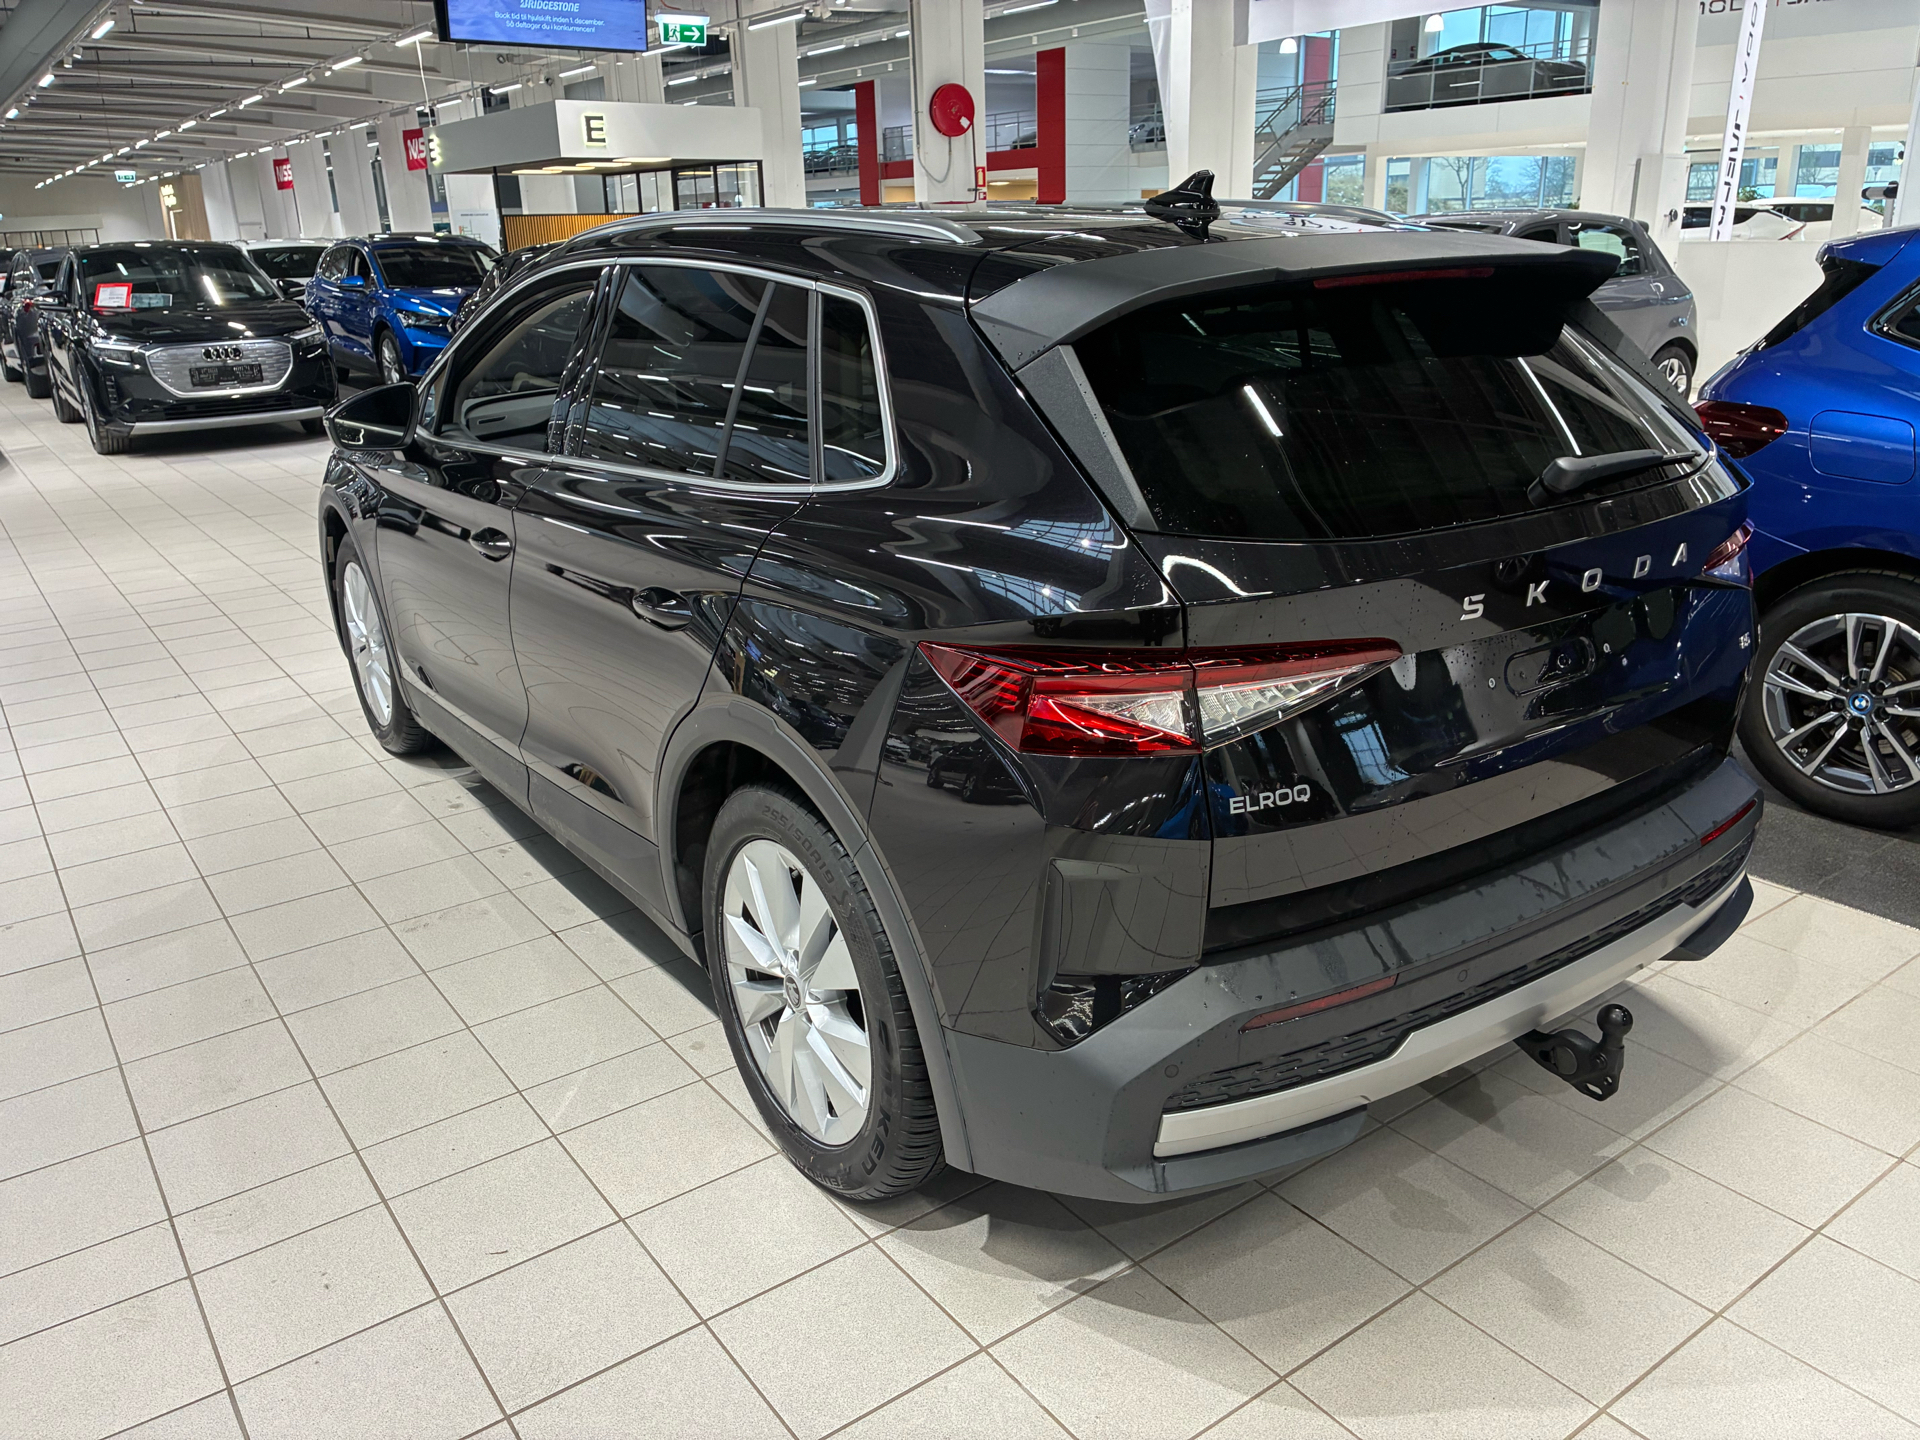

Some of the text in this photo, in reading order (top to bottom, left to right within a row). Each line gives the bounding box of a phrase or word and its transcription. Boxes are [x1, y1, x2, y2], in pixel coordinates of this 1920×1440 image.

[520, 0, 580, 12] BRIDGESTONE
[584, 115, 607, 144] E
[1459, 541, 1689, 622] SKODA
[1229, 783, 1311, 815] ELROQ
